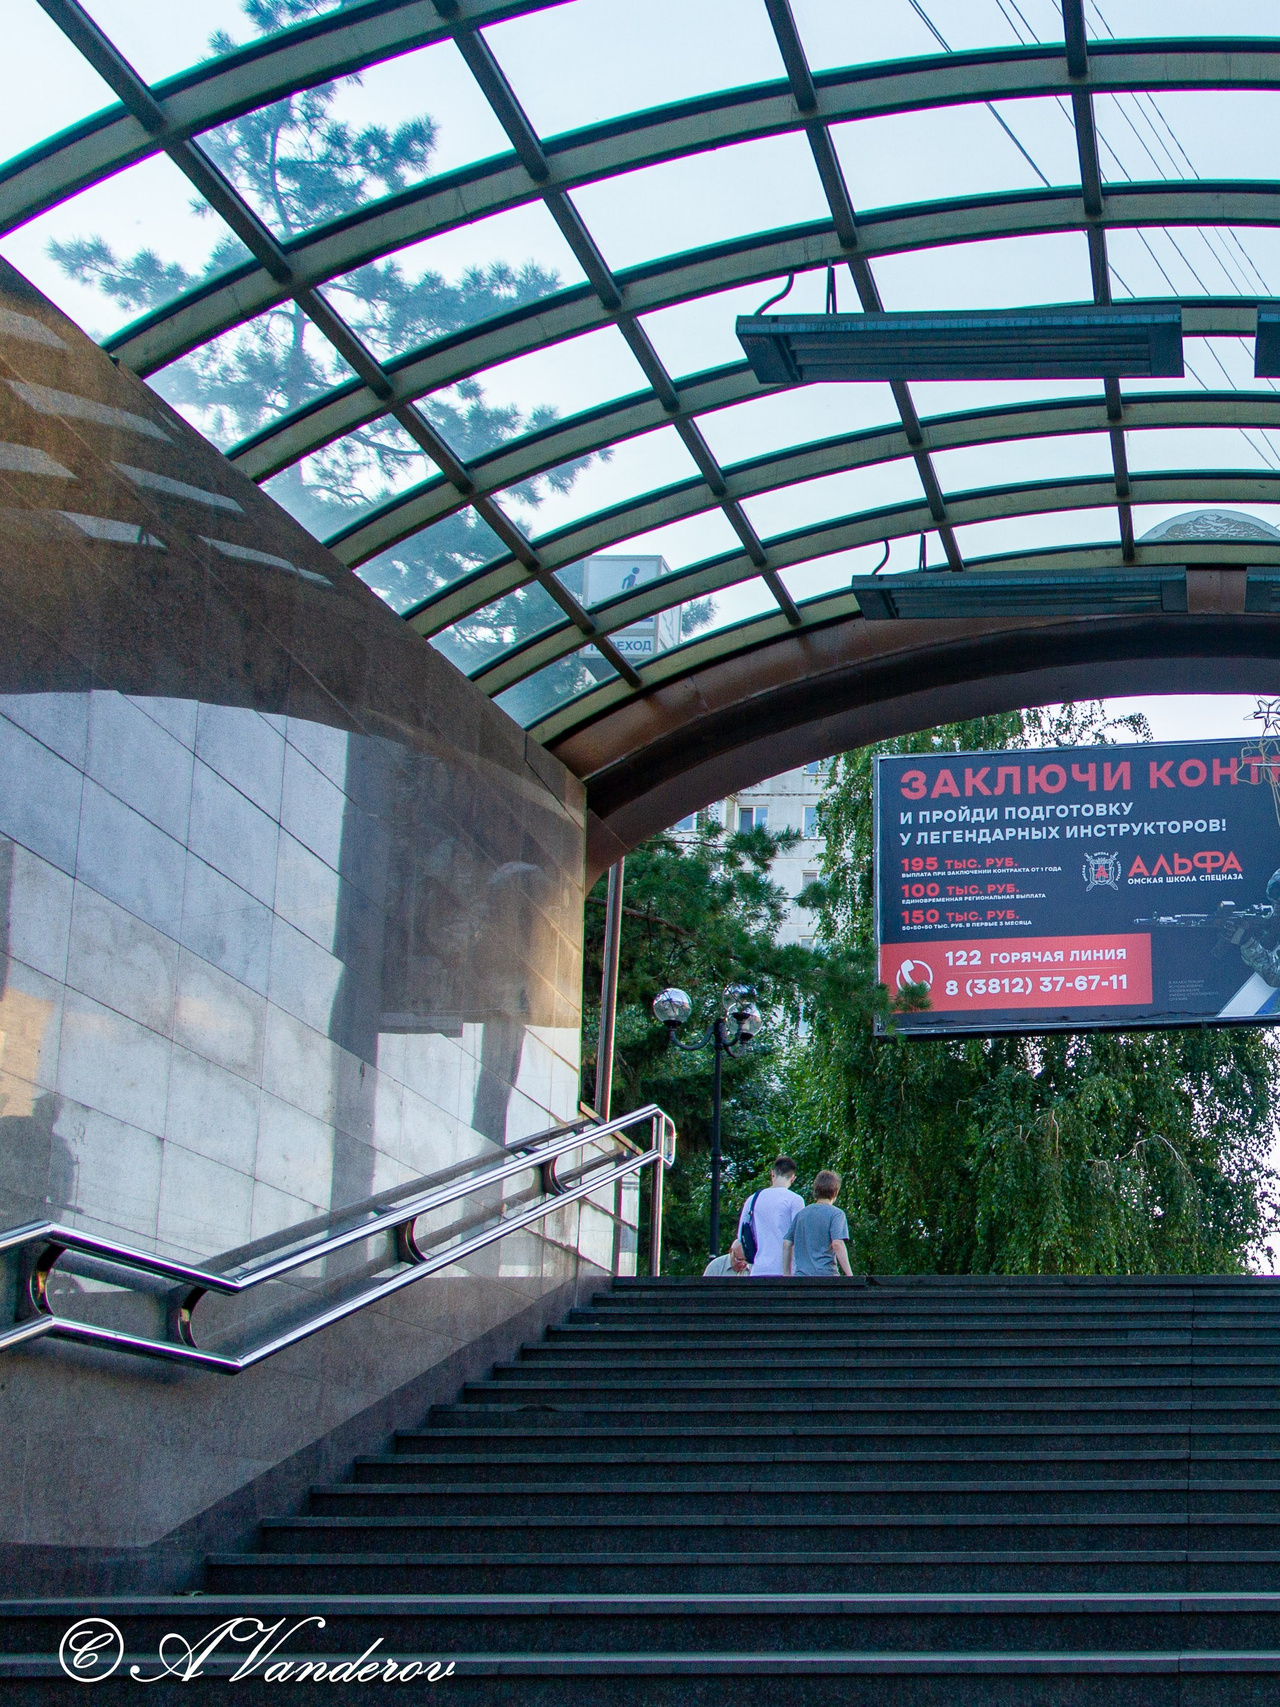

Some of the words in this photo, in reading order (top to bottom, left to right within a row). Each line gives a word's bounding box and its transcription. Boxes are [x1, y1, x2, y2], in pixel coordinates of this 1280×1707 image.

[900, 761, 1131, 800] ЗАКЛЮЧИ
[900, 811, 912, 825] И
[919, 806, 998, 824] ПРОЙДИ
[1004, 802, 1133, 821] ПОДГОТОВКУ
[899, 833, 912, 846] У
[916, 826, 1060, 846] ЛЕГЕНДАРНЫХ
[1065, 819, 1227, 839] ИНСТРУКТОРОВ!
[901, 857, 938, 872] 195
[945, 859, 981, 869] ТЫС.
[985, 857, 1018, 868] РУБ.
[1128, 850, 1243, 877] АЛЬФА
[1127, 877, 1164, 885] ОМСКАЯ
[1166, 876, 1197, 884] ШКОЛА
[1199, 873, 1244, 882] СПЕЦНАЗА
[901, 883, 940, 898] 100
[946, 885, 983, 896] ТЫС.
[987, 883, 1020, 894] РУБ.
[901, 896, 963, 905] ЕДИНОВРЕМЕННАЯ
[964, 894, 1015, 902] РЕГИОНАЛЬНАЯ
[901, 909, 940, 924] 150
[945, 911, 982, 922] ТЫС.
[987, 910, 1020, 920] РУБ.
[945, 950, 982, 966] 122
[990, 950, 1064, 964] ГОРЯЧАЯ
[1069, 948, 1127, 962] ЛИНИЯ
[945, 980, 958, 996] 8
[966, 977, 1033, 997] (3812)
[1039, 974, 1128, 992] 37-67-11
